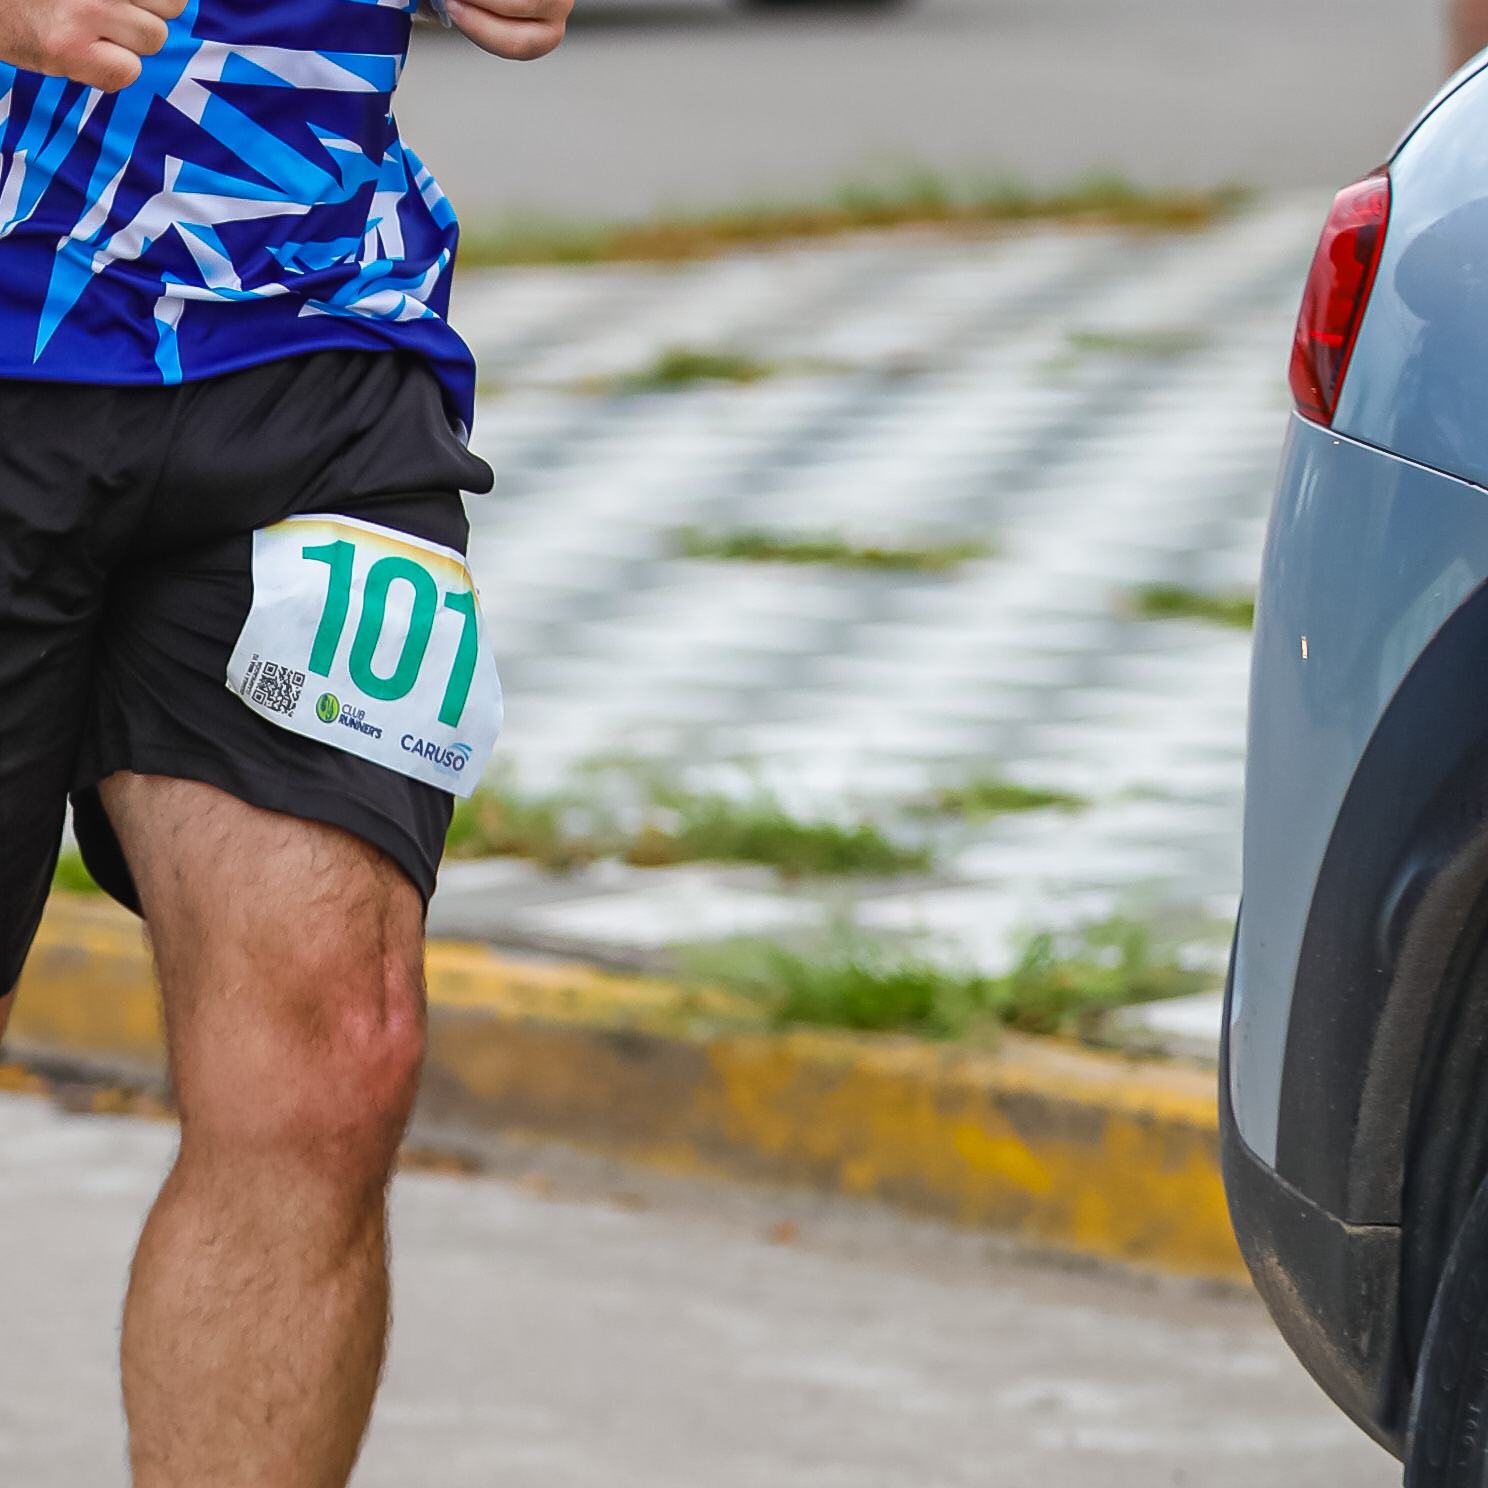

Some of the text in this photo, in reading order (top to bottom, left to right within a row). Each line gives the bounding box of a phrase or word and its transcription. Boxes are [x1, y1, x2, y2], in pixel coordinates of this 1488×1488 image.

[302, 539, 479, 728] 101
[342, 703, 366, 720] CLUB
[400, 734, 465, 772] CARUSO
